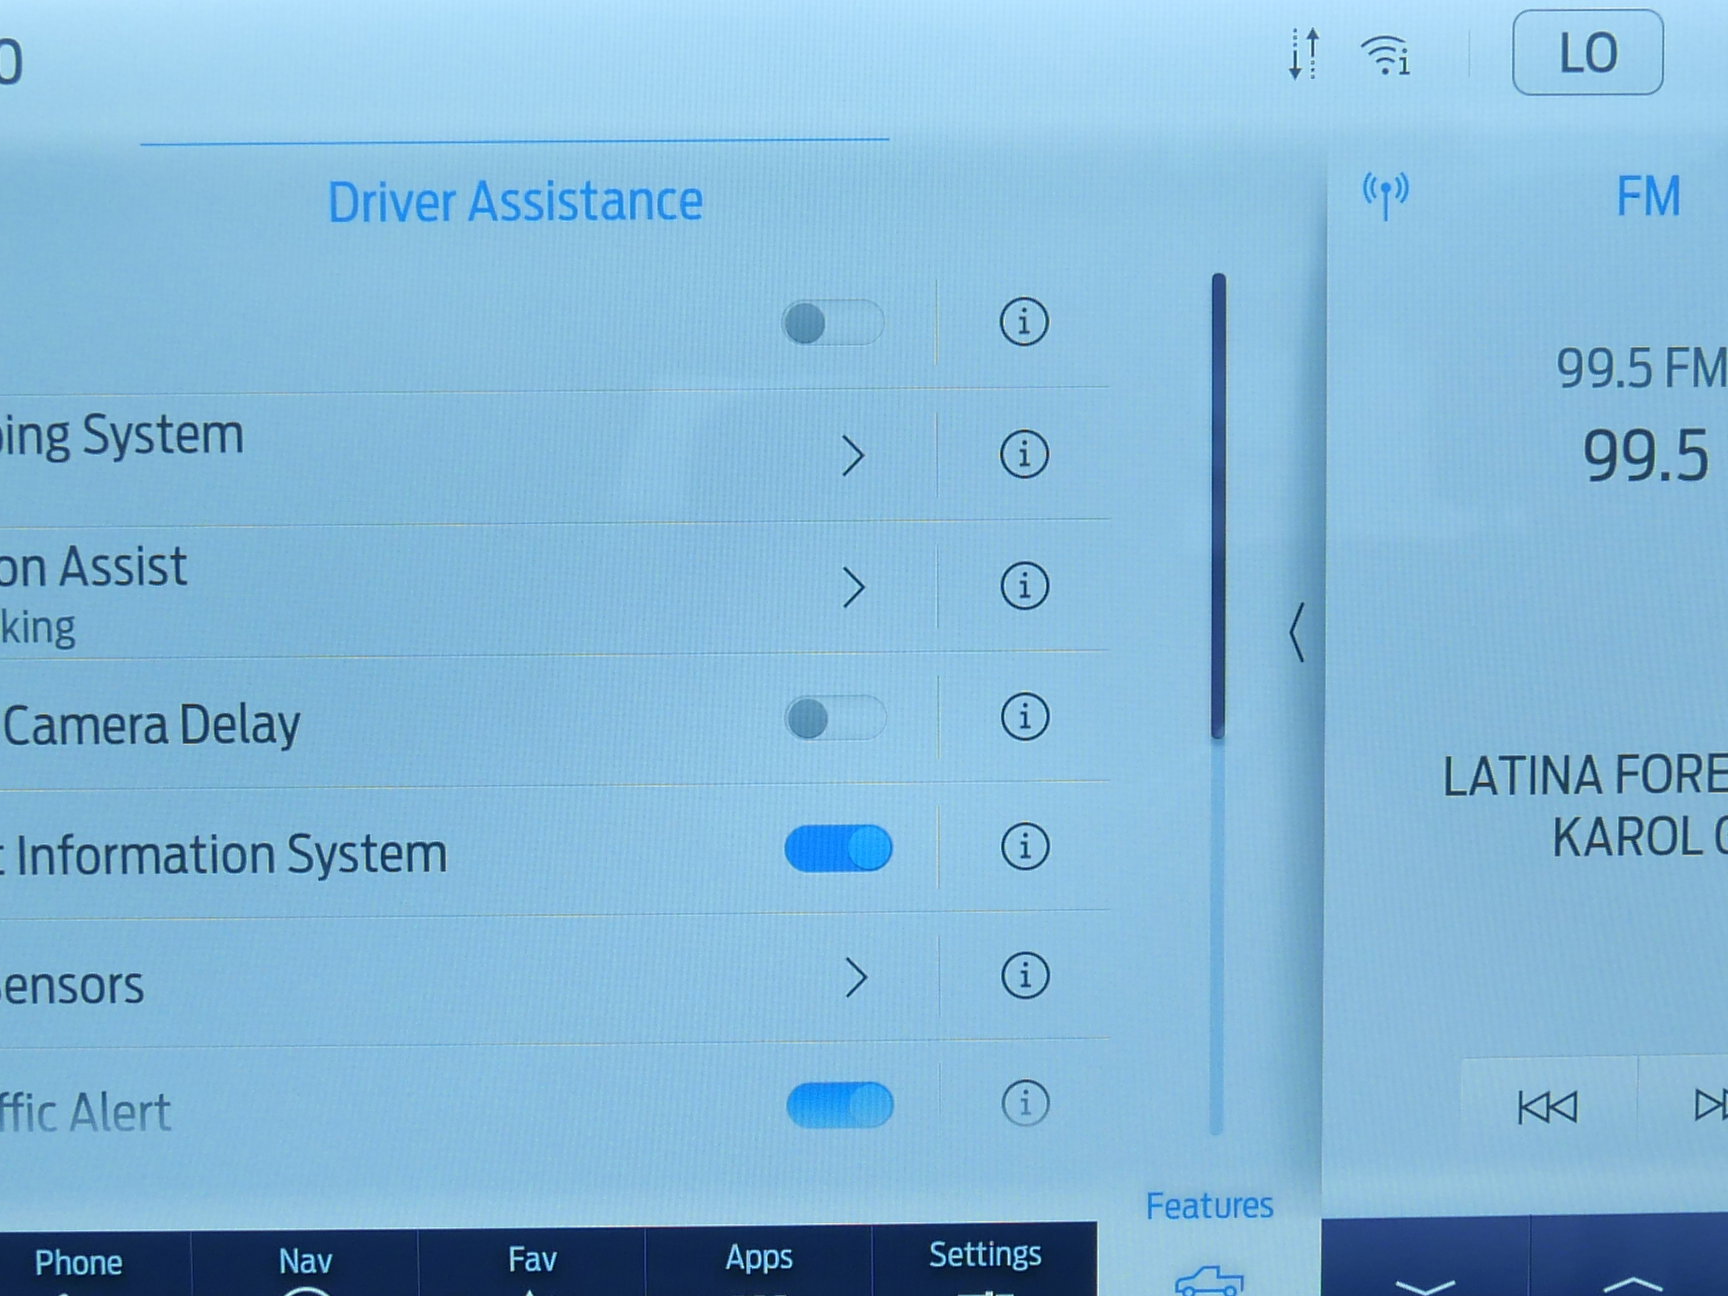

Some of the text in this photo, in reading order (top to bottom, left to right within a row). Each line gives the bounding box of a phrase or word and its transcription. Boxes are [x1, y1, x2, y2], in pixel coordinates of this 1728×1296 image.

[1561, 30, 1619, 74] LO
[329, 179, 704, 224] Driver Assistance
[1618, 174, 1680, 217] FM
[1557, 345, 1728, 389] 99.5 FM
[83, 412, 244, 463] System
[1584, 427, 1709, 483] 99.5
[58, 544, 188, 587] Assist
[3, 704, 170, 746] Camera
[180, 701, 301, 752] Delay
[1445, 753, 1603, 797] LATINA
[18, 832, 275, 876] Information
[288, 832, 448, 882] System
[1554, 815, 1704, 857] KAROL
[70, 1090, 172, 1131] Alert
[1147, 1191, 1275, 1221] Features
[35, 1248, 123, 1276] Phone
[279, 1247, 333, 1274] Nav
[509, 1245, 558, 1273] Fav
[725, 1243, 794, 1275] Apps
[929, 1240, 1043, 1272] Settings
